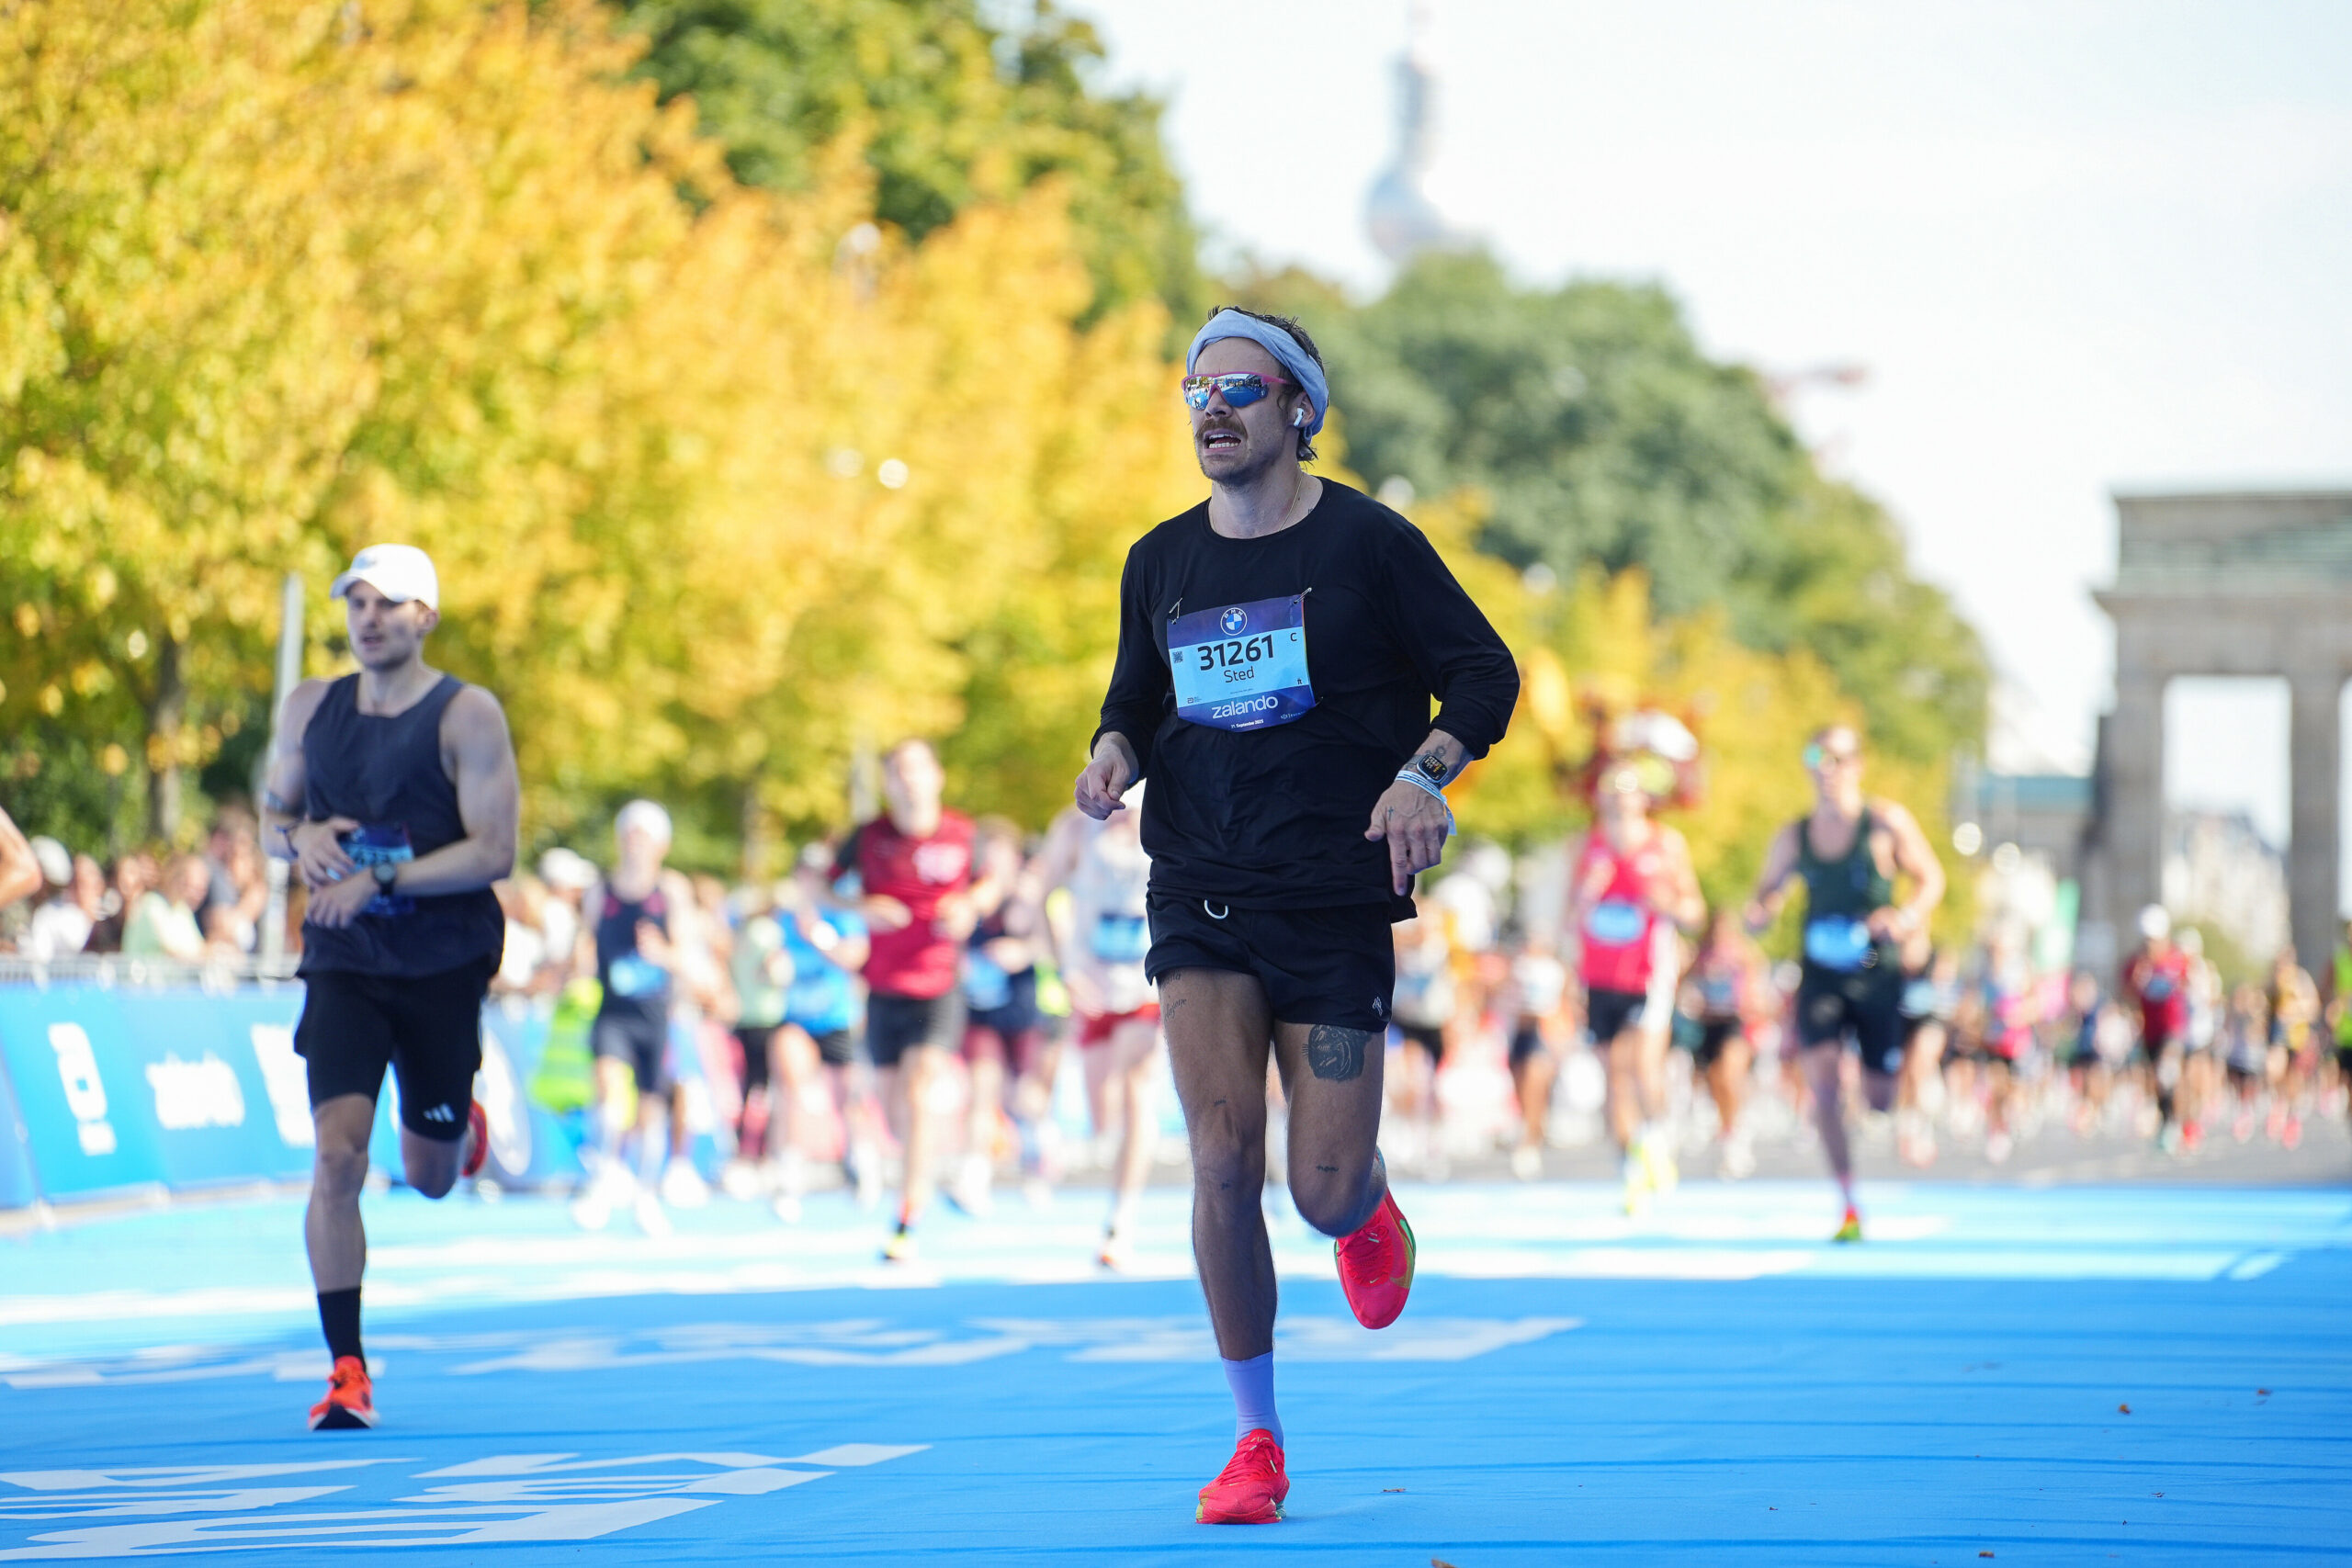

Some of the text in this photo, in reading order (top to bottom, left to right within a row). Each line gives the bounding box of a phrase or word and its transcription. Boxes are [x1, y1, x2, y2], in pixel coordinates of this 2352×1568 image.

[1290, 632, 1297, 642] C
[1197, 634, 1274, 671] 31261
[1224, 666, 1255, 683] Sted
[1212, 694, 1279, 719] zalando
